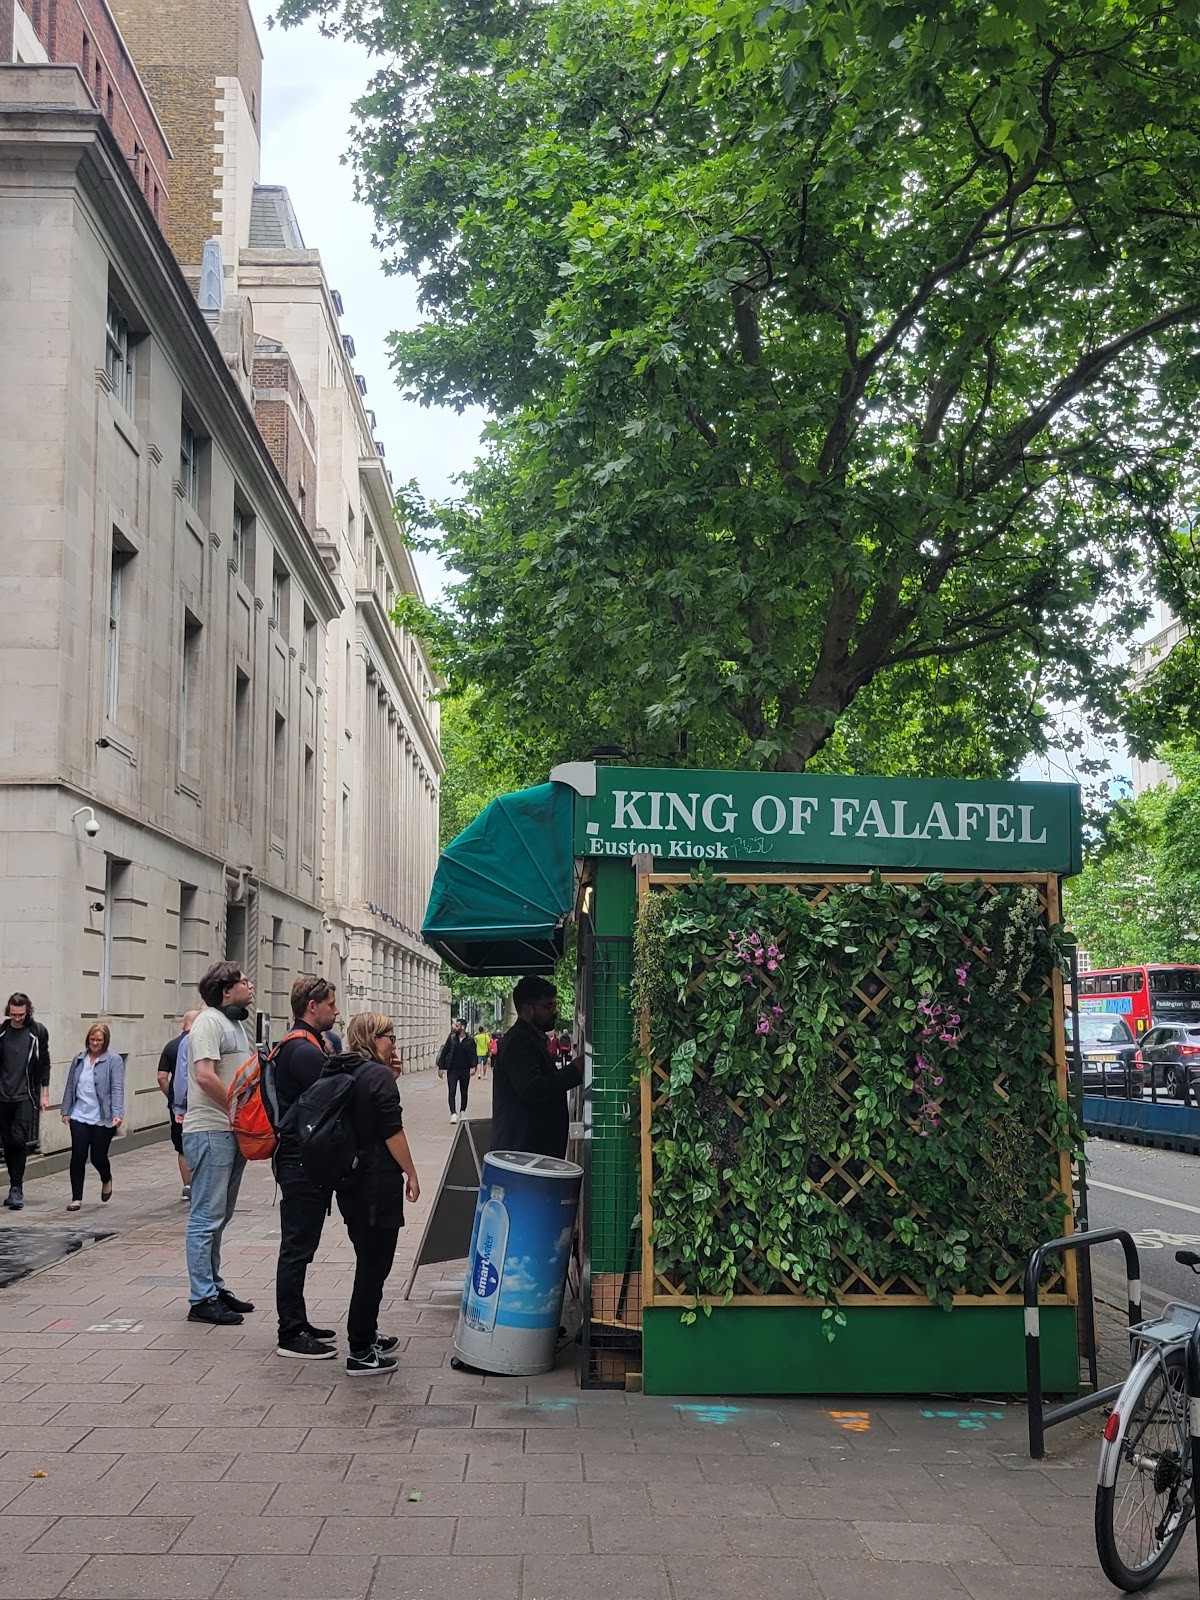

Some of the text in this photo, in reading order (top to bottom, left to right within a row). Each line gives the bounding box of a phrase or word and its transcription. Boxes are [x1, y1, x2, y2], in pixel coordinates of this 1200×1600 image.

[610, 790, 1048, 844] KING OF FALAFEL
[589, 838, 663, 857] Euston
[668, 840, 729, 859] Kiosk
[1156, 1000, 1184, 1008] Paddington
[477, 1233, 494, 1297] smartwater
